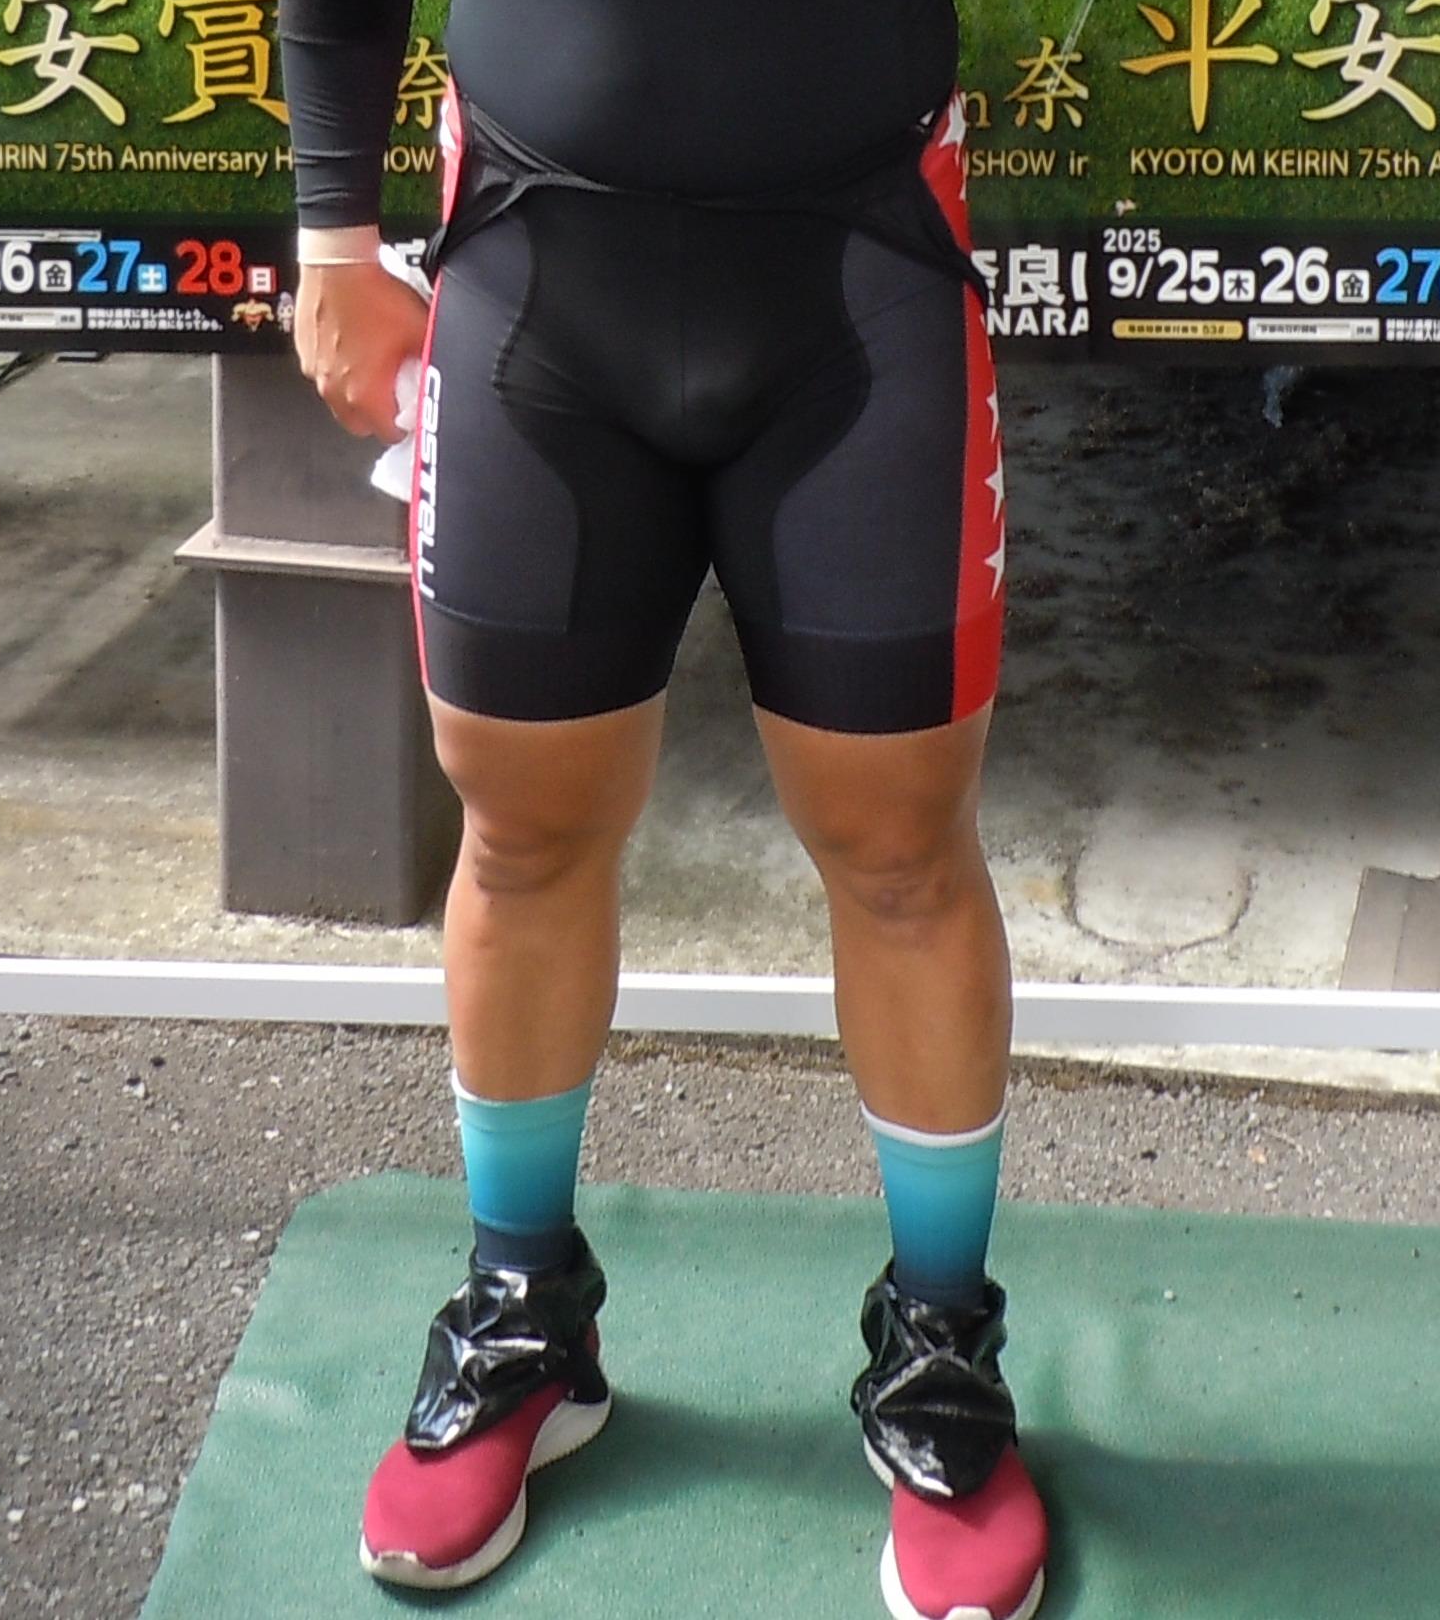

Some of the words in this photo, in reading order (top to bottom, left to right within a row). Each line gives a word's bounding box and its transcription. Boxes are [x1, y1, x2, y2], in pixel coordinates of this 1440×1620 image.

[964, 88, 991, 128] n
[1004, 36, 1089, 131] 奈
[55, 143, 113, 172] 75th
[120, 142, 267, 179] Anniversary
[1130, 148, 1224, 177] KYOTO
[1230, 149, 1256, 177] M
[1263, 148, 1349, 177] KEIRIN
[1358, 147, 1421, 178] 75th
[1102, 227, 1161, 254] 2025
[76, 240, 141, 294] 27
[176, 240, 245, 294] 28
[1260, 246, 1331, 304] 26
[986, 306, 1090, 337] NARA
